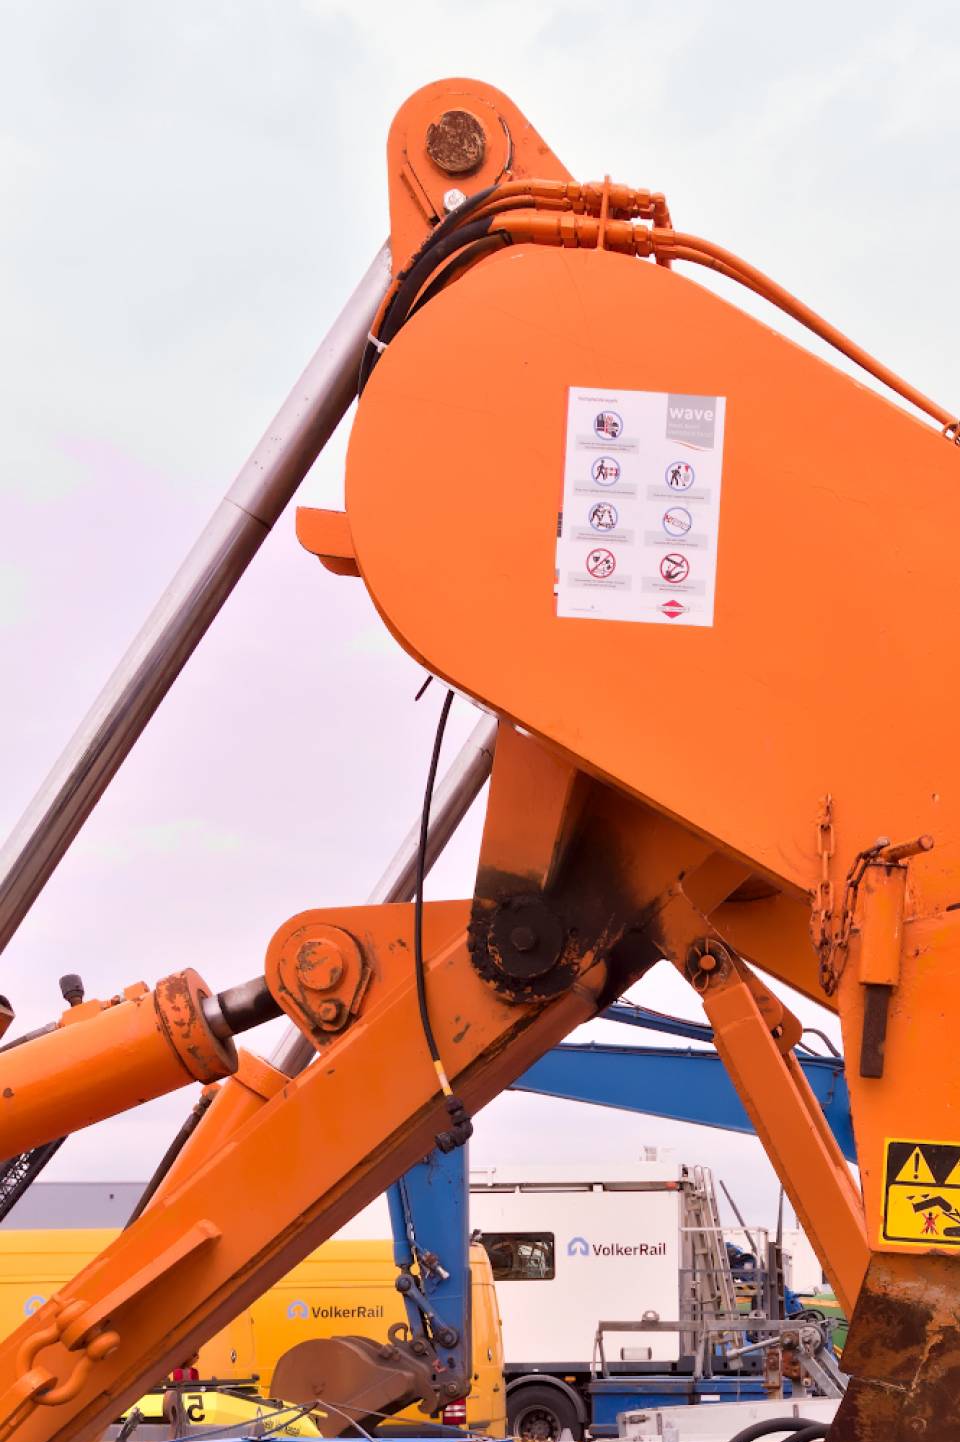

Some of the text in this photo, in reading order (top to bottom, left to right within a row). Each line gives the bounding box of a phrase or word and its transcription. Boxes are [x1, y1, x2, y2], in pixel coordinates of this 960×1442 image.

[669, 407, 714, 421] wave
[592, 1242, 666, 1256] VolkerRail
[311, 1305, 384, 1318] VolkerRail
